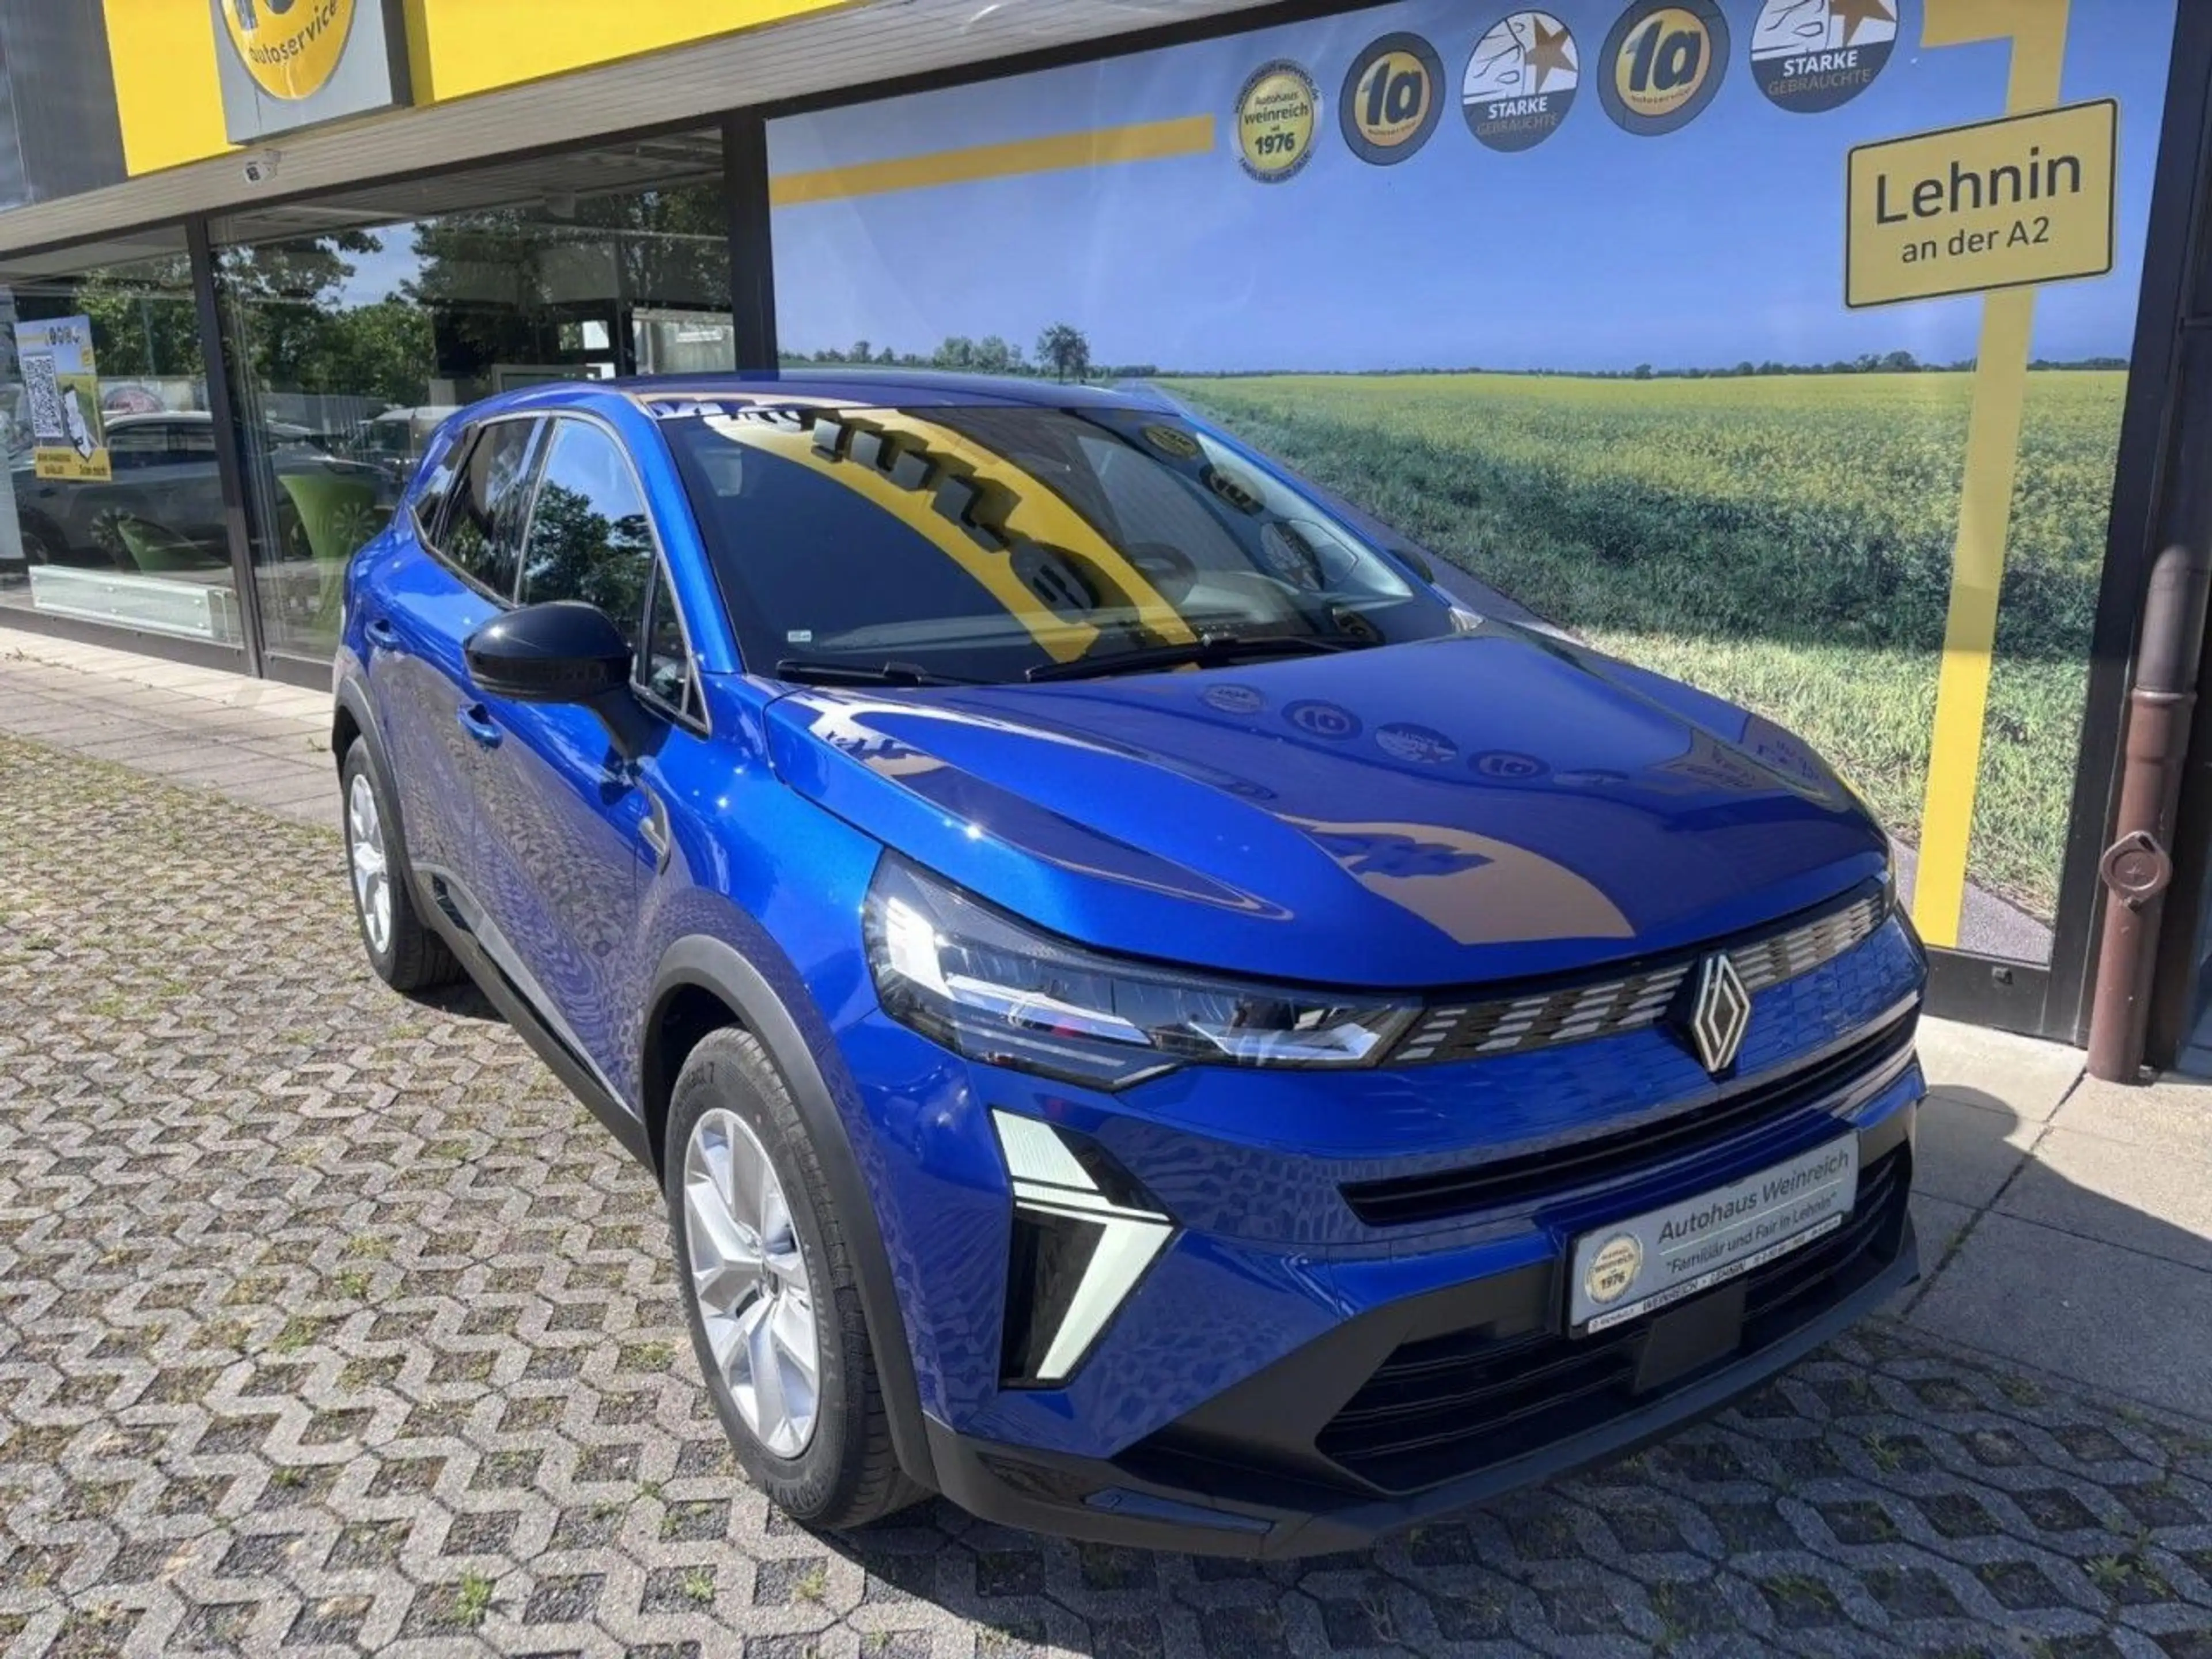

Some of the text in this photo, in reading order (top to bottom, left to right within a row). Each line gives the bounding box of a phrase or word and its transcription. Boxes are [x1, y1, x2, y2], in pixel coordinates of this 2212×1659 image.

[1627, 20, 1702, 92] 1a
[1783, 49, 1858, 77] STARKE
[1358, 61, 1422, 126] 1a
[1767, 68, 1872, 97] GEBRAUCHTE
[1487, 96, 1548, 120] STARKE
[1255, 132, 1296, 156] 1976
[1876, 146, 2081, 225] Lehnin
[1902, 216, 2050, 264] an der A2
[1658, 1149, 1849, 1245] Autohaus Weinreich
[1728, 1228, 1753, 1252] und
[1756, 1218, 1778, 1239] Fair
[1601, 1271, 1626, 1290] 1976
